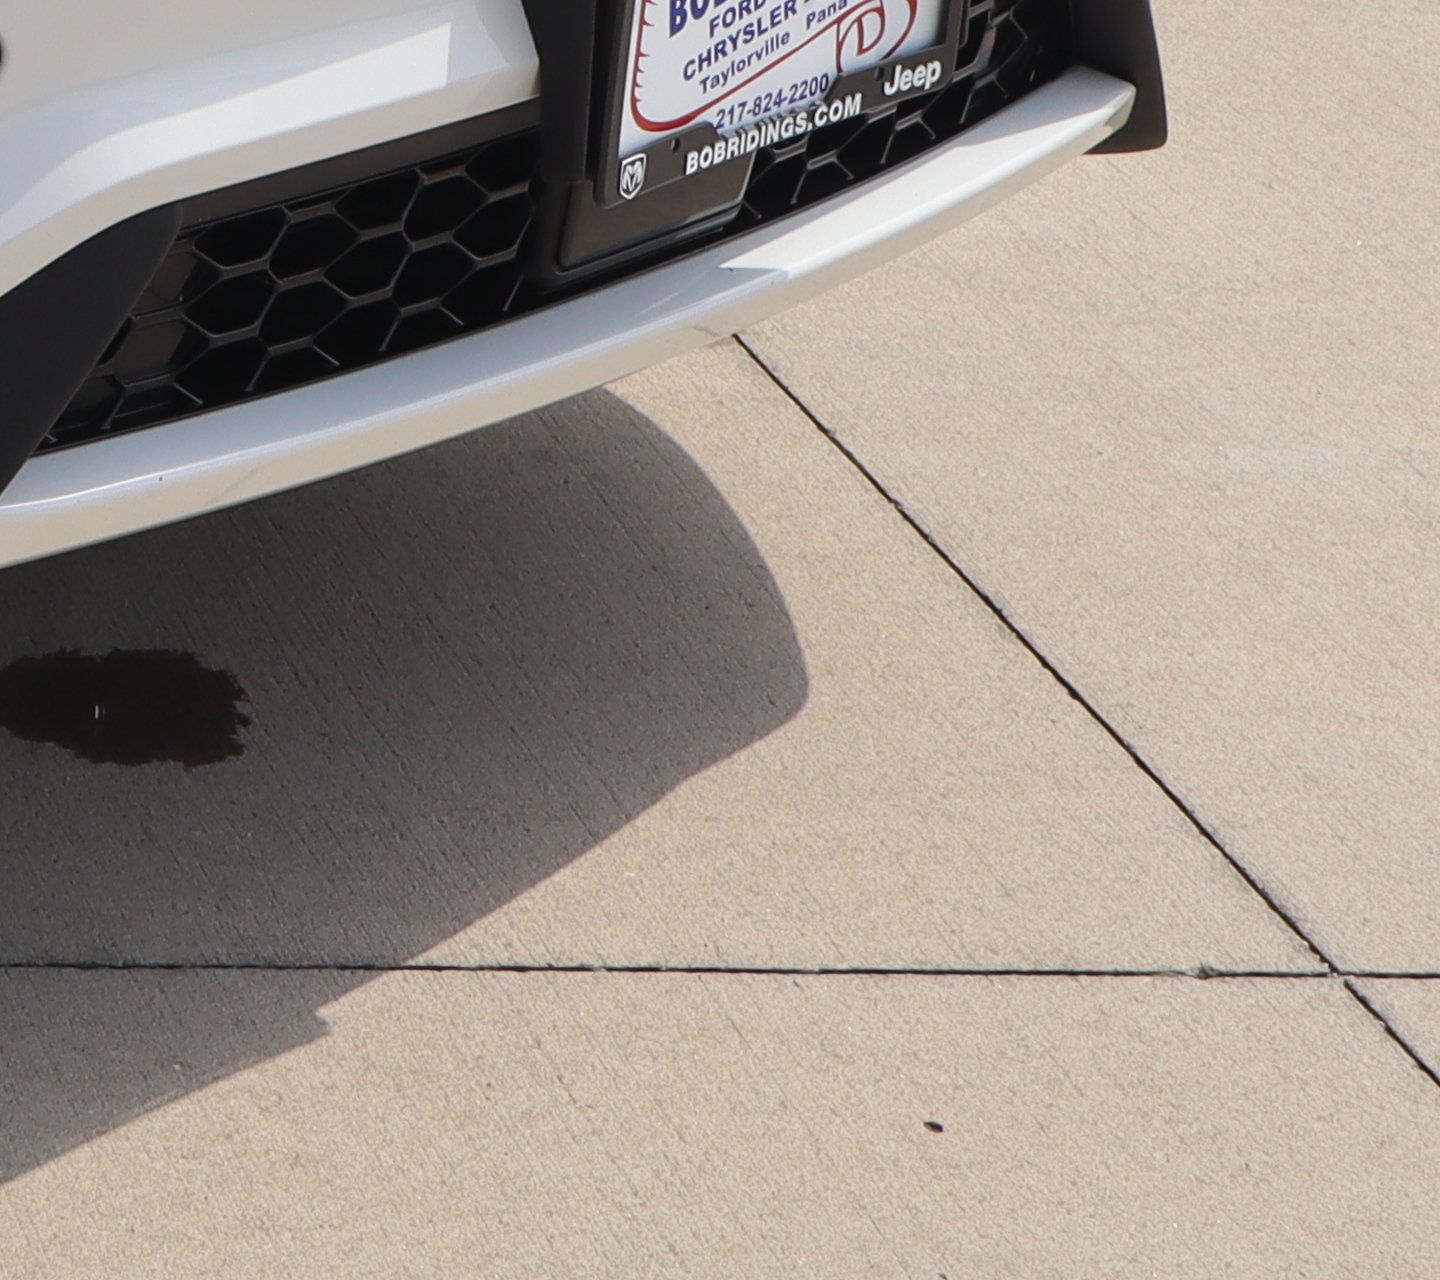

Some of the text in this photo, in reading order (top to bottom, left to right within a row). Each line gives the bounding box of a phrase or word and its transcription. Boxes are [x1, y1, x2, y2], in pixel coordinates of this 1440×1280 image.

[699, 31, 791, 94] Taylorville
[883, 60, 942, 96] Jeep
[714, 72, 830, 130] 217-824-2200
[684, 92, 863, 176] BOBRIDINGS.COM
